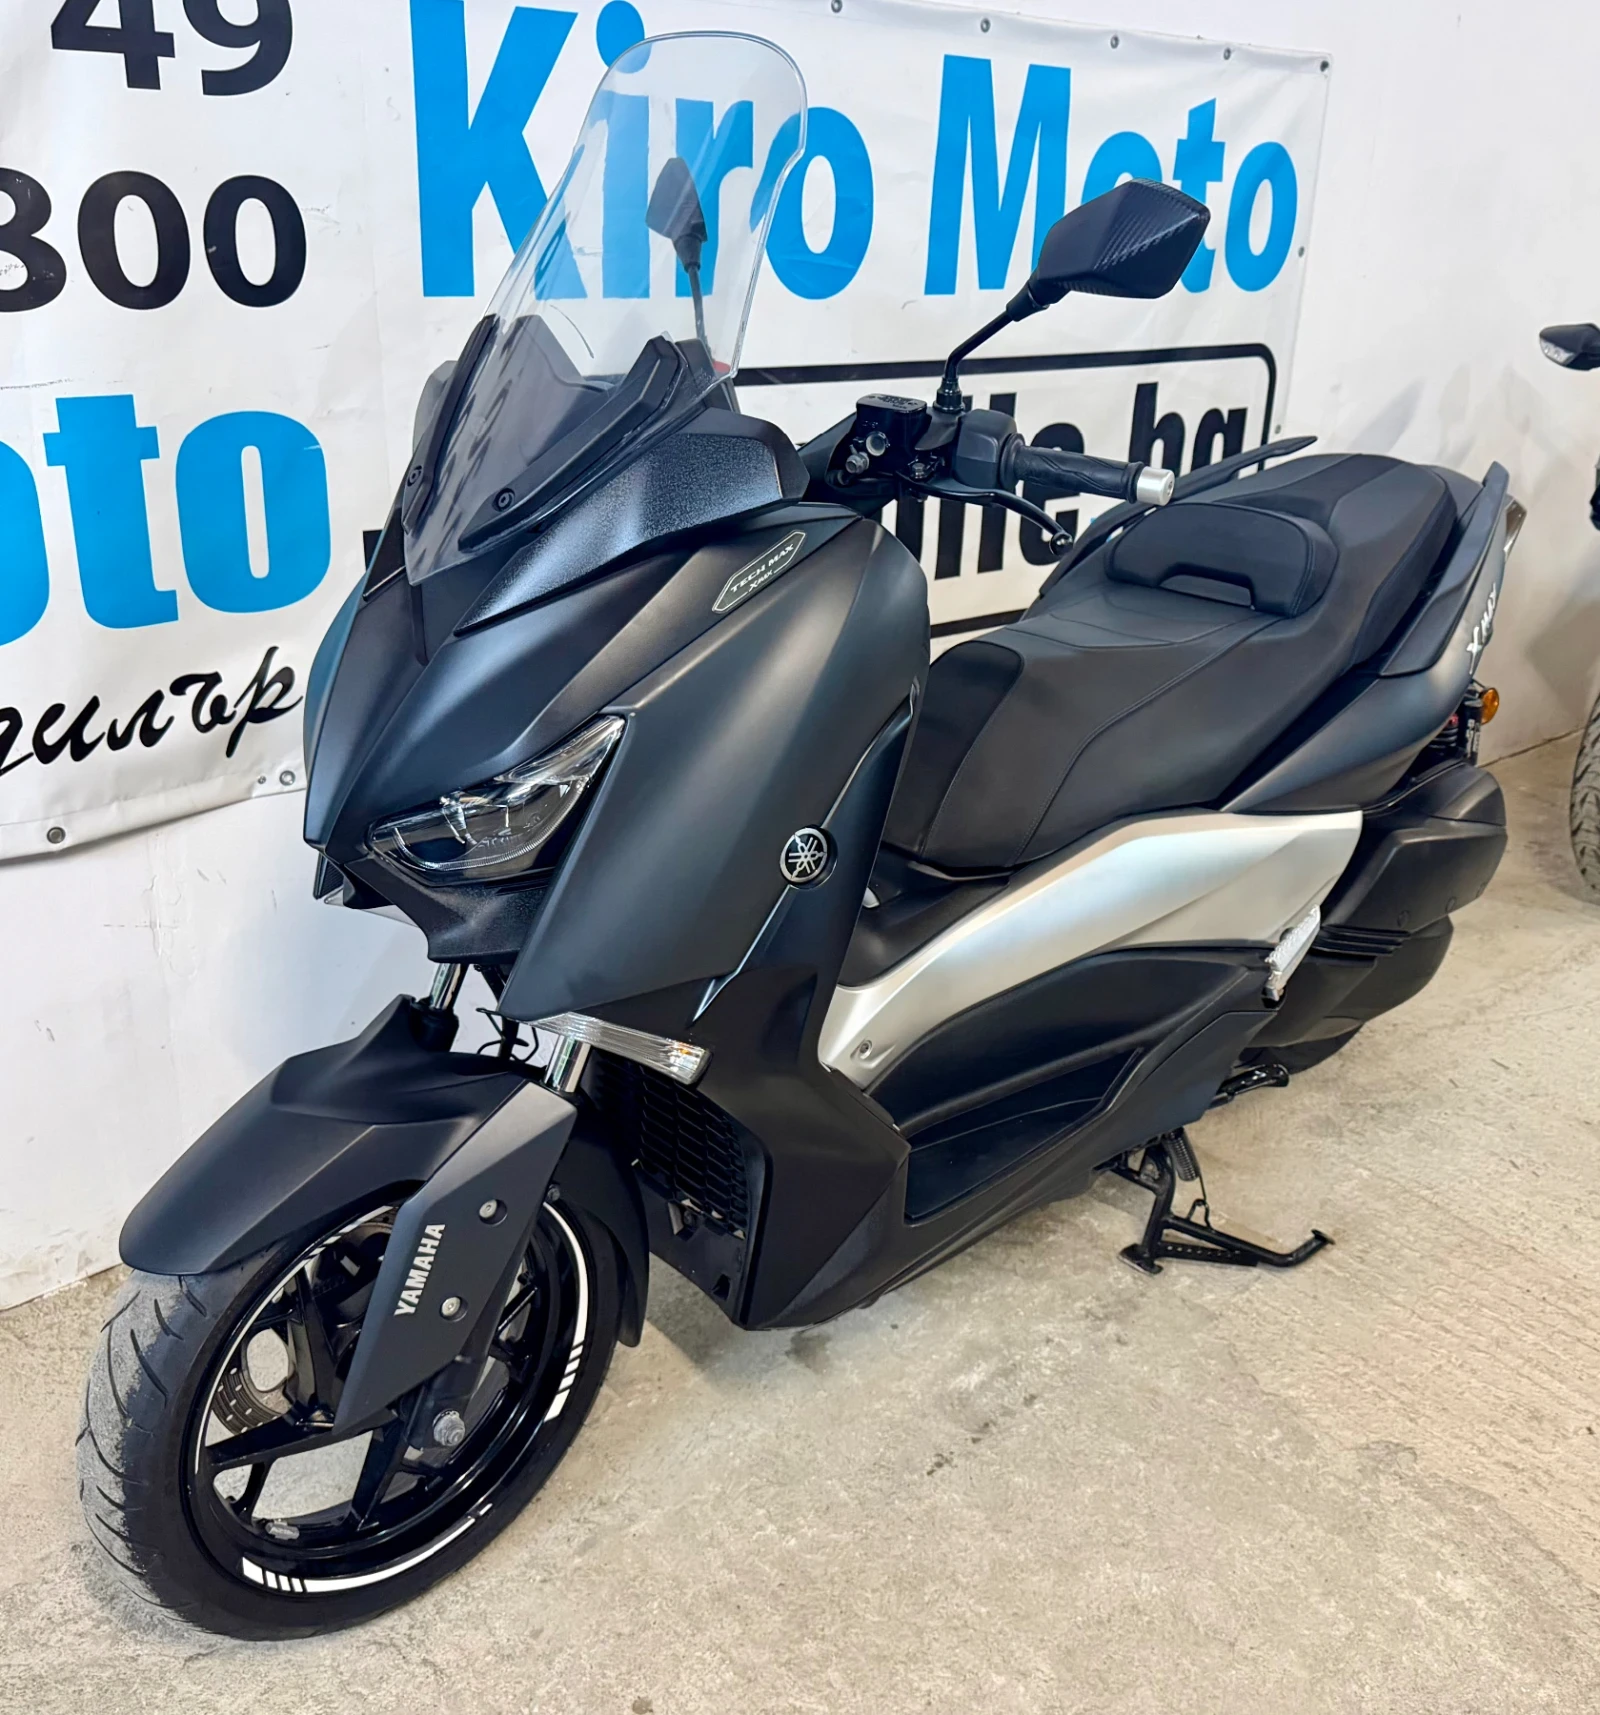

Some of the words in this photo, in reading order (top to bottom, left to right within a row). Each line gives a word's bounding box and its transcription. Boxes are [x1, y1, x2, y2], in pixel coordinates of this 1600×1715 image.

[51, 0, 293, 96] 49
[409, 0, 875, 300] Kiro
[0, 167, 307, 312] 800
[730, 564, 766, 593] TECH
[768, 543, 795, 567] MAX
[394, 1224, 446, 1316] YAMAHA
